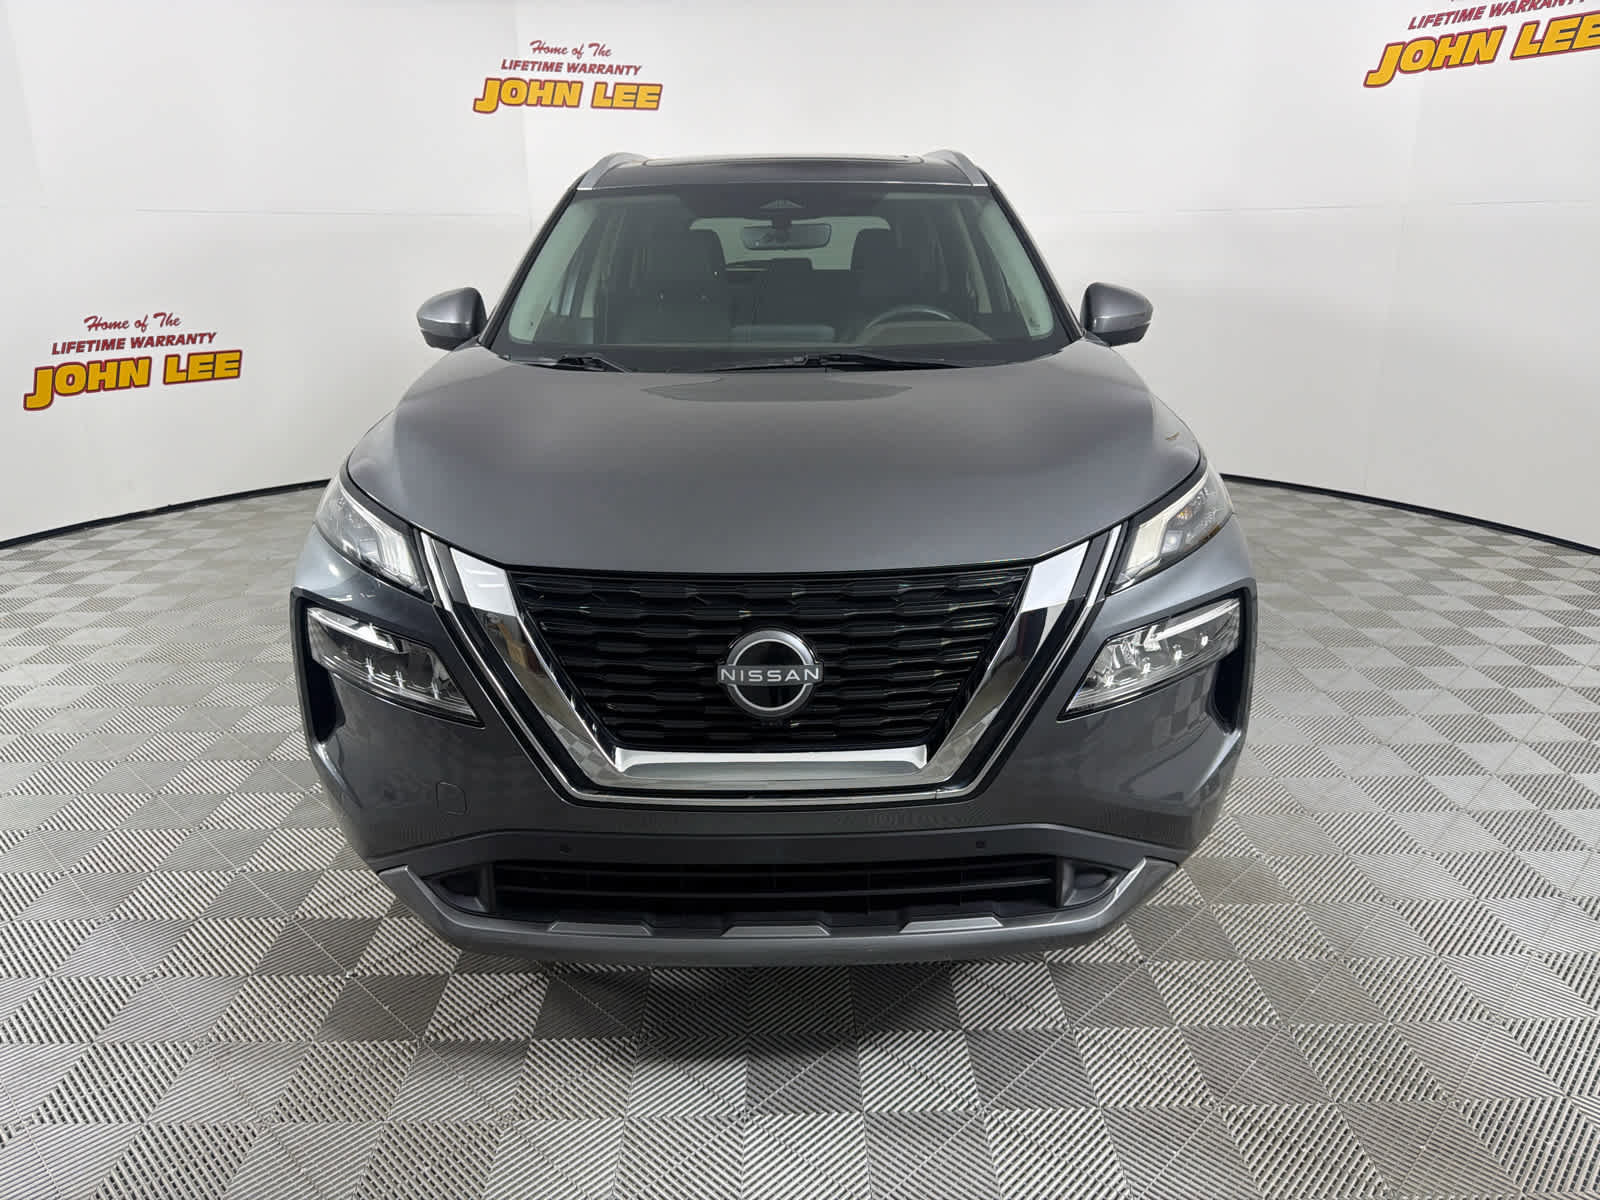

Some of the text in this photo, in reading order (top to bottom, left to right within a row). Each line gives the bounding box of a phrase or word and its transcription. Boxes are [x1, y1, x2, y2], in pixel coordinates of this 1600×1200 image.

[1407, 0, 1585, 30] LIFETIME WARRA
[529, 39, 612, 60] Home of The
[1363, 9, 1600, 89] JOHN LEE
[500, 58, 642, 76] LIFETIME WARRANTY
[472, 77, 663, 114] JOHN LEE
[83, 311, 182, 333] Home of The
[51, 331, 217, 356] LIFETIME WARRANTY
[23, 349, 243, 412] JOHN LEE
[720, 667, 820, 682] NISSAN
